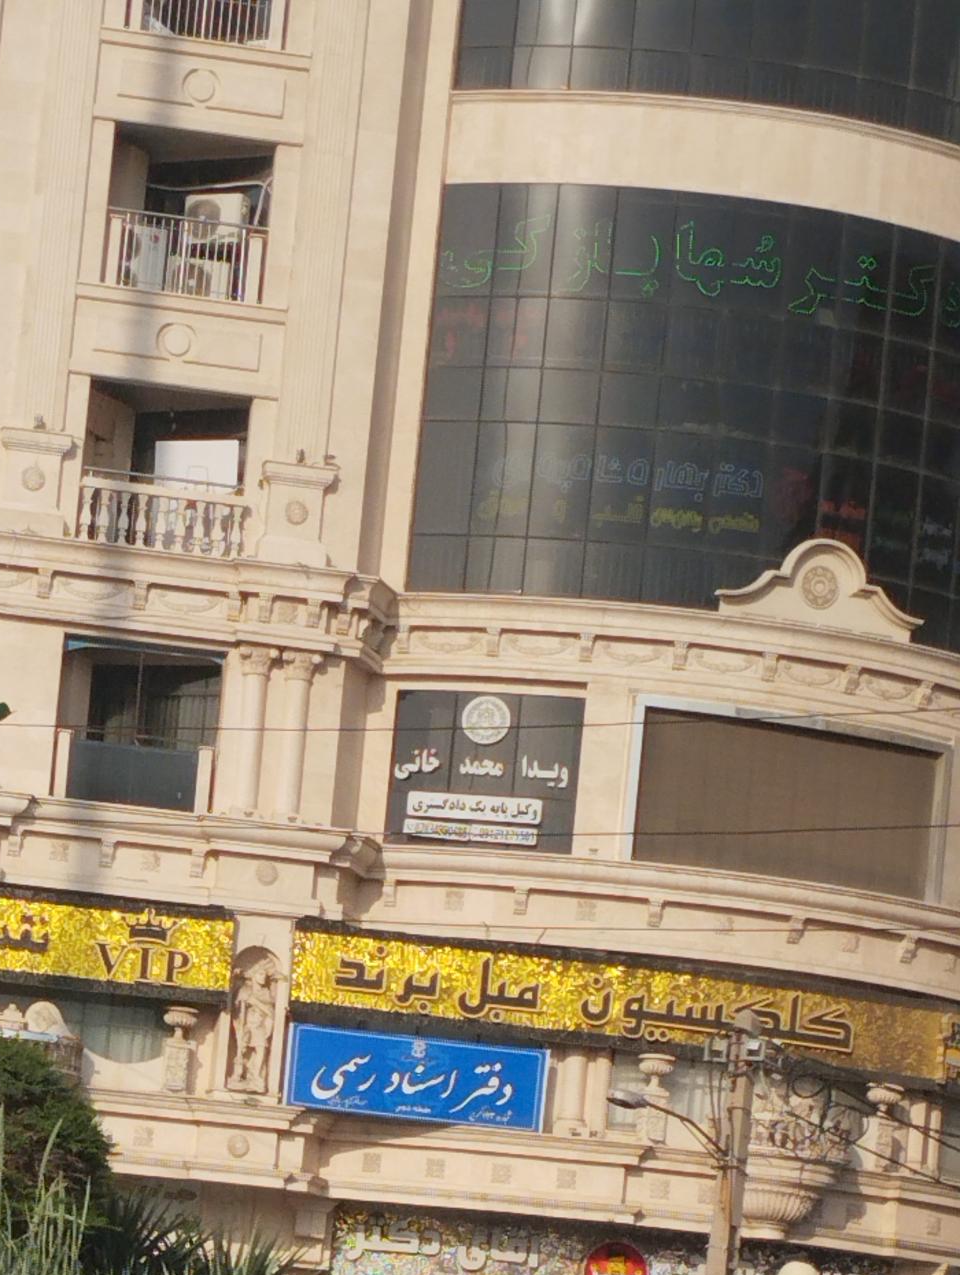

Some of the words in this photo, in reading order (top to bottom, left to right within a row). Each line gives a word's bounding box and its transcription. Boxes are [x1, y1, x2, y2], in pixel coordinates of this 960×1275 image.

[394, 748, 440, 780] خانی
[458, 756, 504, 777] محمد
[521, 755, 569, 788] ویدا
[412, 798, 467, 814] دادگستری
[469, 800, 486, 815] یک
[489, 801, 509, 818] پایه
[510, 803, 538, 821] وکیل
[95, 942, 191, 986] VIP
[334, 944, 440, 1012] برند
[457, 956, 542, 1022] مبل
[579, 975, 854, 1053] کلکسیون
[311, 1054, 377, 1099] رسمی
[384, 1064, 458, 1099] اسناد
[450, 1062, 513, 1113] دفتر
[344, 1215, 442, 1261] دکتر
